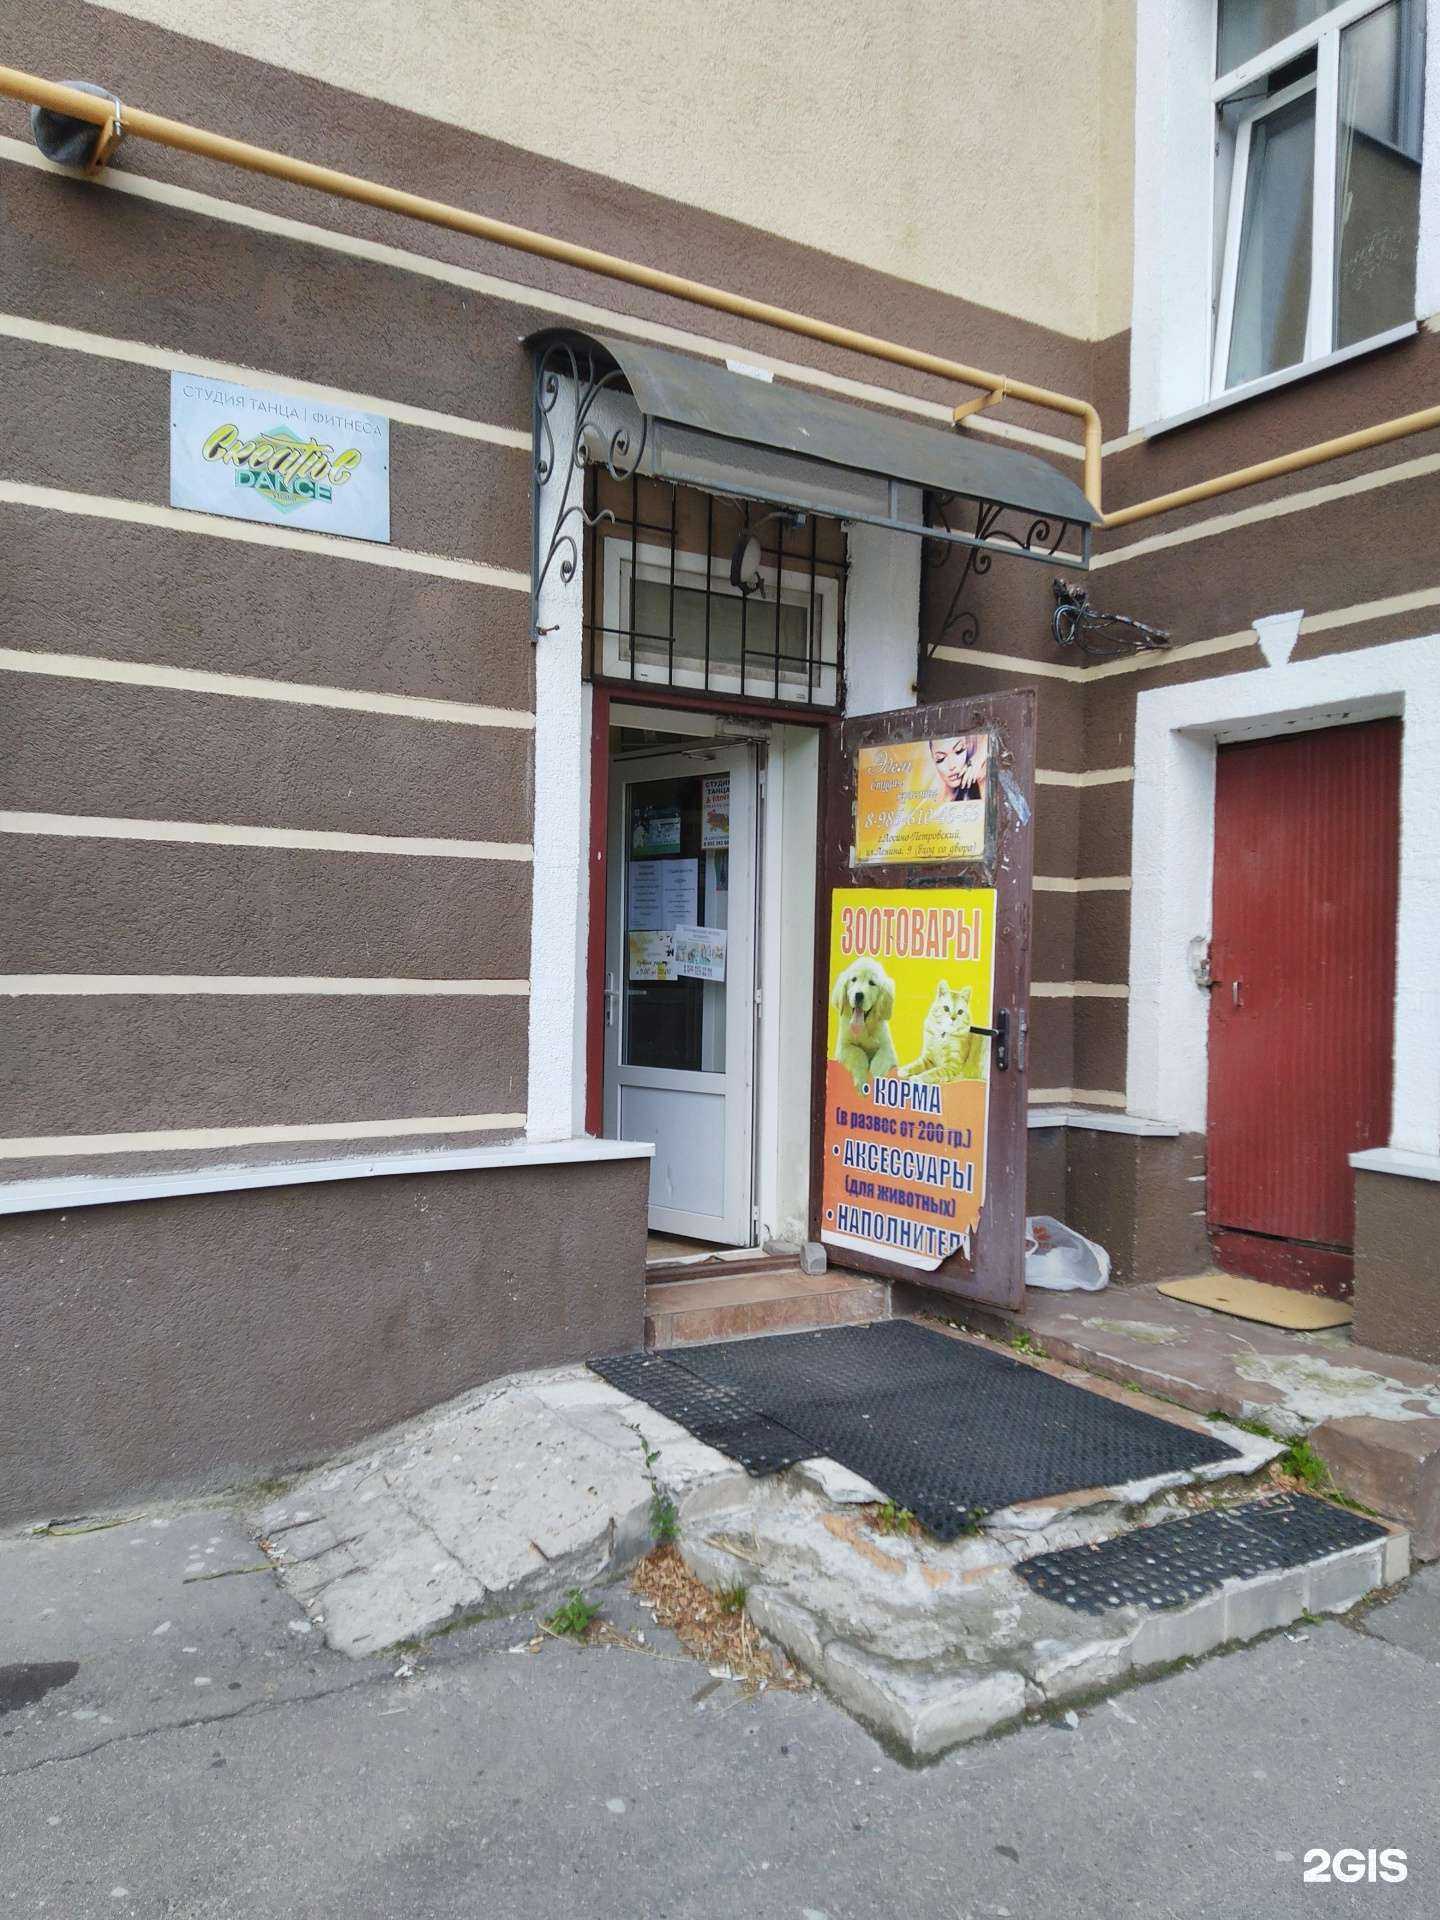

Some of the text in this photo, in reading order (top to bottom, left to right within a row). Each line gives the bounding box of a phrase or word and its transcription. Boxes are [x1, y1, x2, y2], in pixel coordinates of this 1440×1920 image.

[183, 385, 382, 437] СТУДИЯ ТАНЦА ФИТНЕСА
[235, 467, 332, 504] DANCE
[841, 905, 982, 961] ЗООТОВАРЫ
[874, 1077, 942, 1115] КОРМА
[836, 1107, 848, 1126] (в
[899, 1121, 915, 1138] от
[918, 1120, 944, 1144] 200
[947, 1129, 972, 1149] гр.)
[844, 1139, 975, 1193] АКСЕССУАРЫ
[844, 1174, 956, 1218] (для животных)
[838, 1204, 970, 1257] НАПОЛНИТЕЛ
